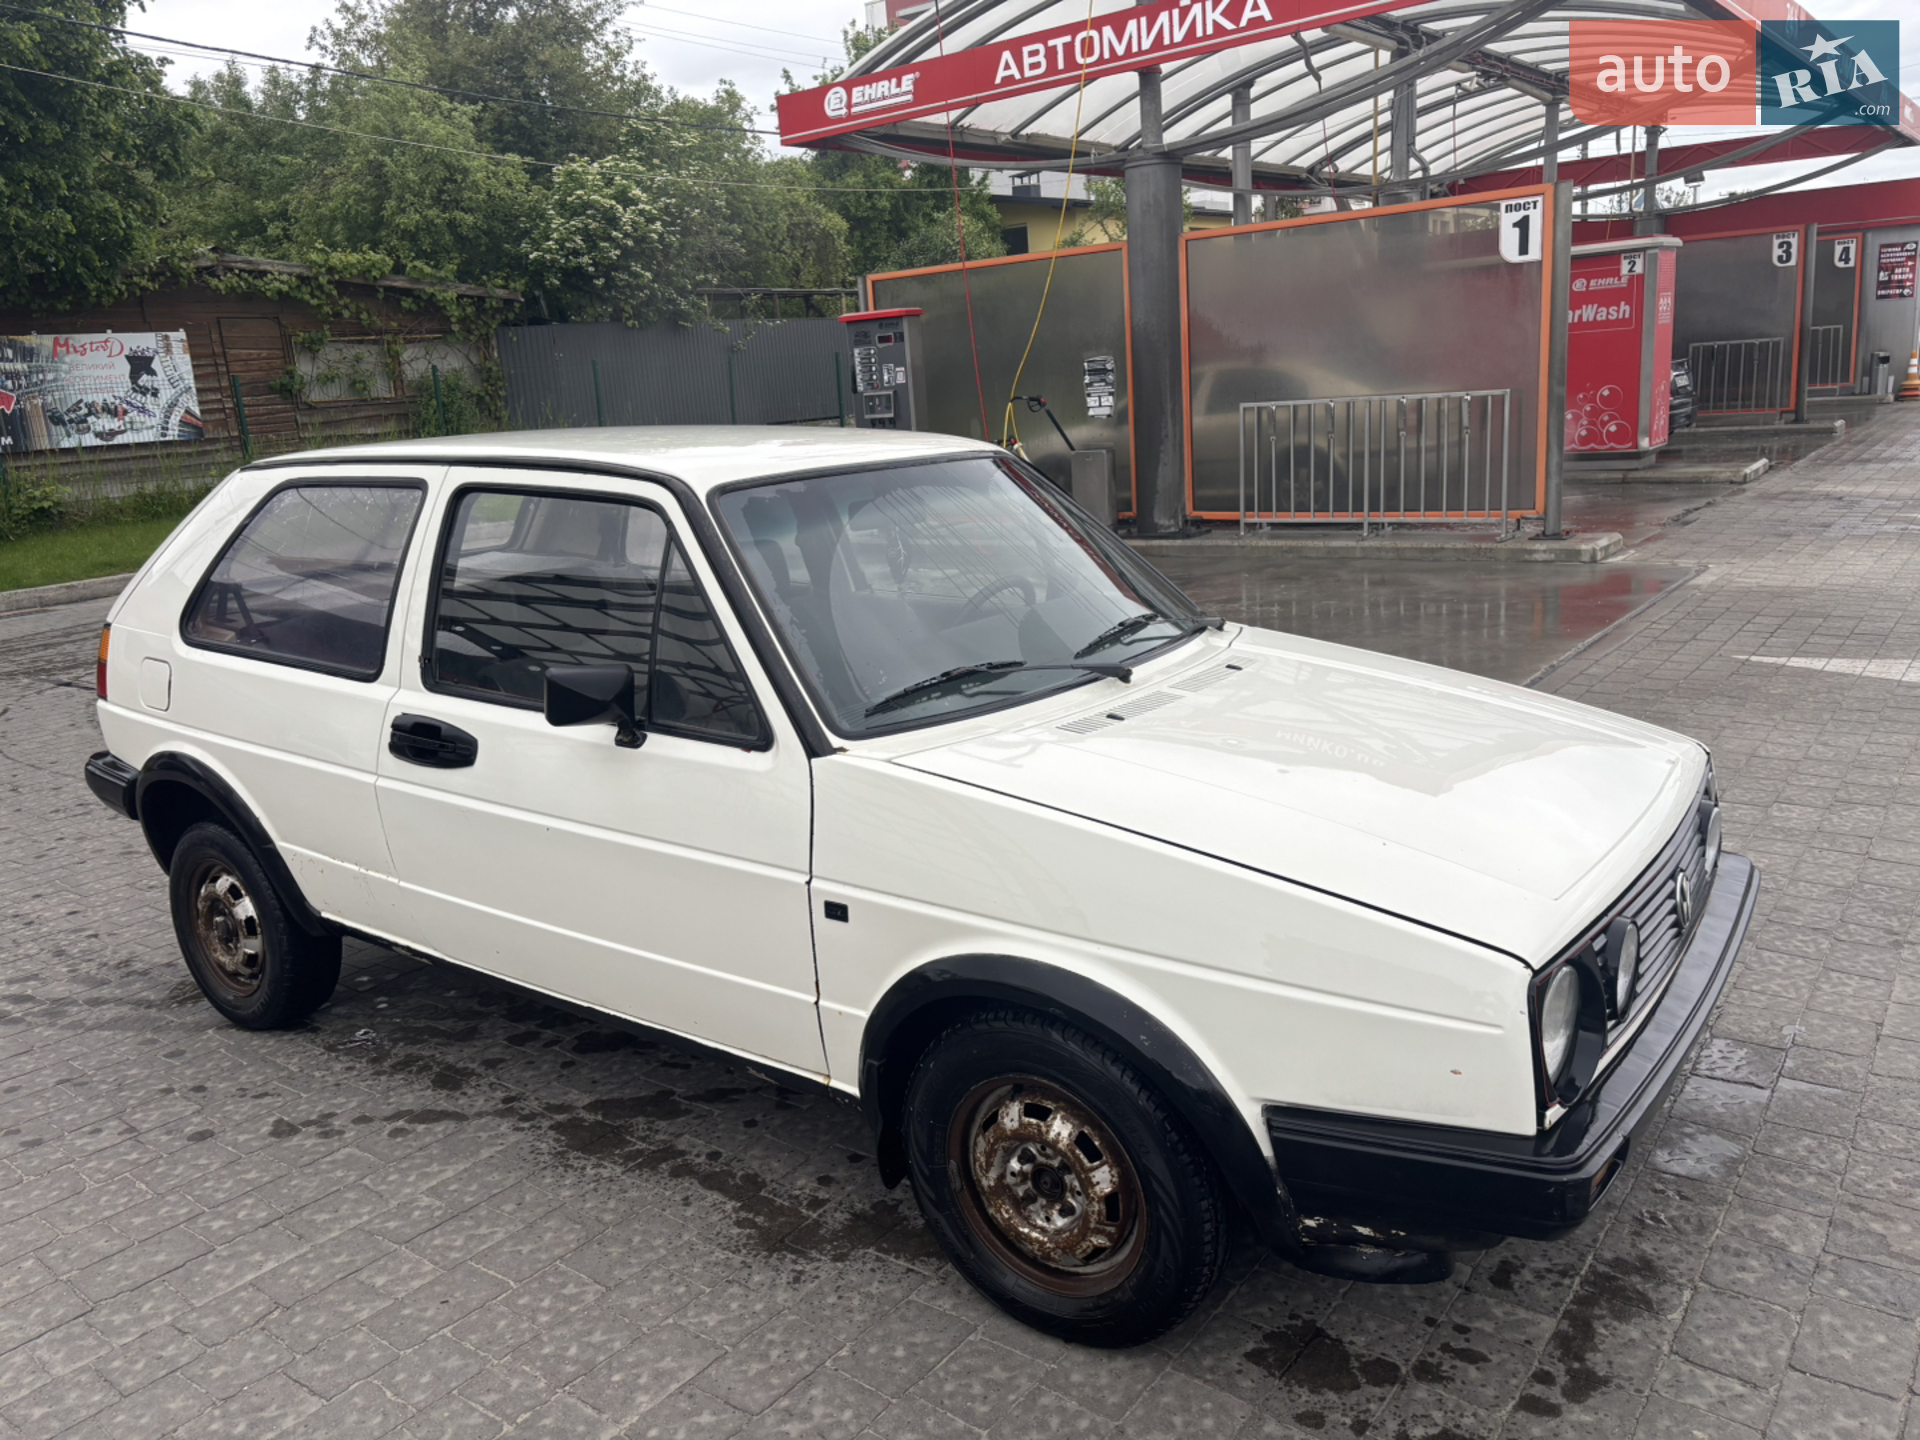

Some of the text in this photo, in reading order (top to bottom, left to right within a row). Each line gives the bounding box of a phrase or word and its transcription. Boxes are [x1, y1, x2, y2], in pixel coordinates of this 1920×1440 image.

[994, 0, 1273, 84] АВТОМИЙКА
[1504, 200, 1539, 213] ПОСТ
[1512, 214, 1530, 257] 1
[1777, 240, 1793, 265] 3
[1838, 246, 1852, 265] 4
[1627, 260, 1637, 273] 2
[1589, 276, 1629, 287] EHRLE
[1568, 301, 1631, 323] rWash
[68, 361, 116, 371] ВЕЛИКИЙ
[63, 374, 125, 384] АСОРТИМЕНТ
